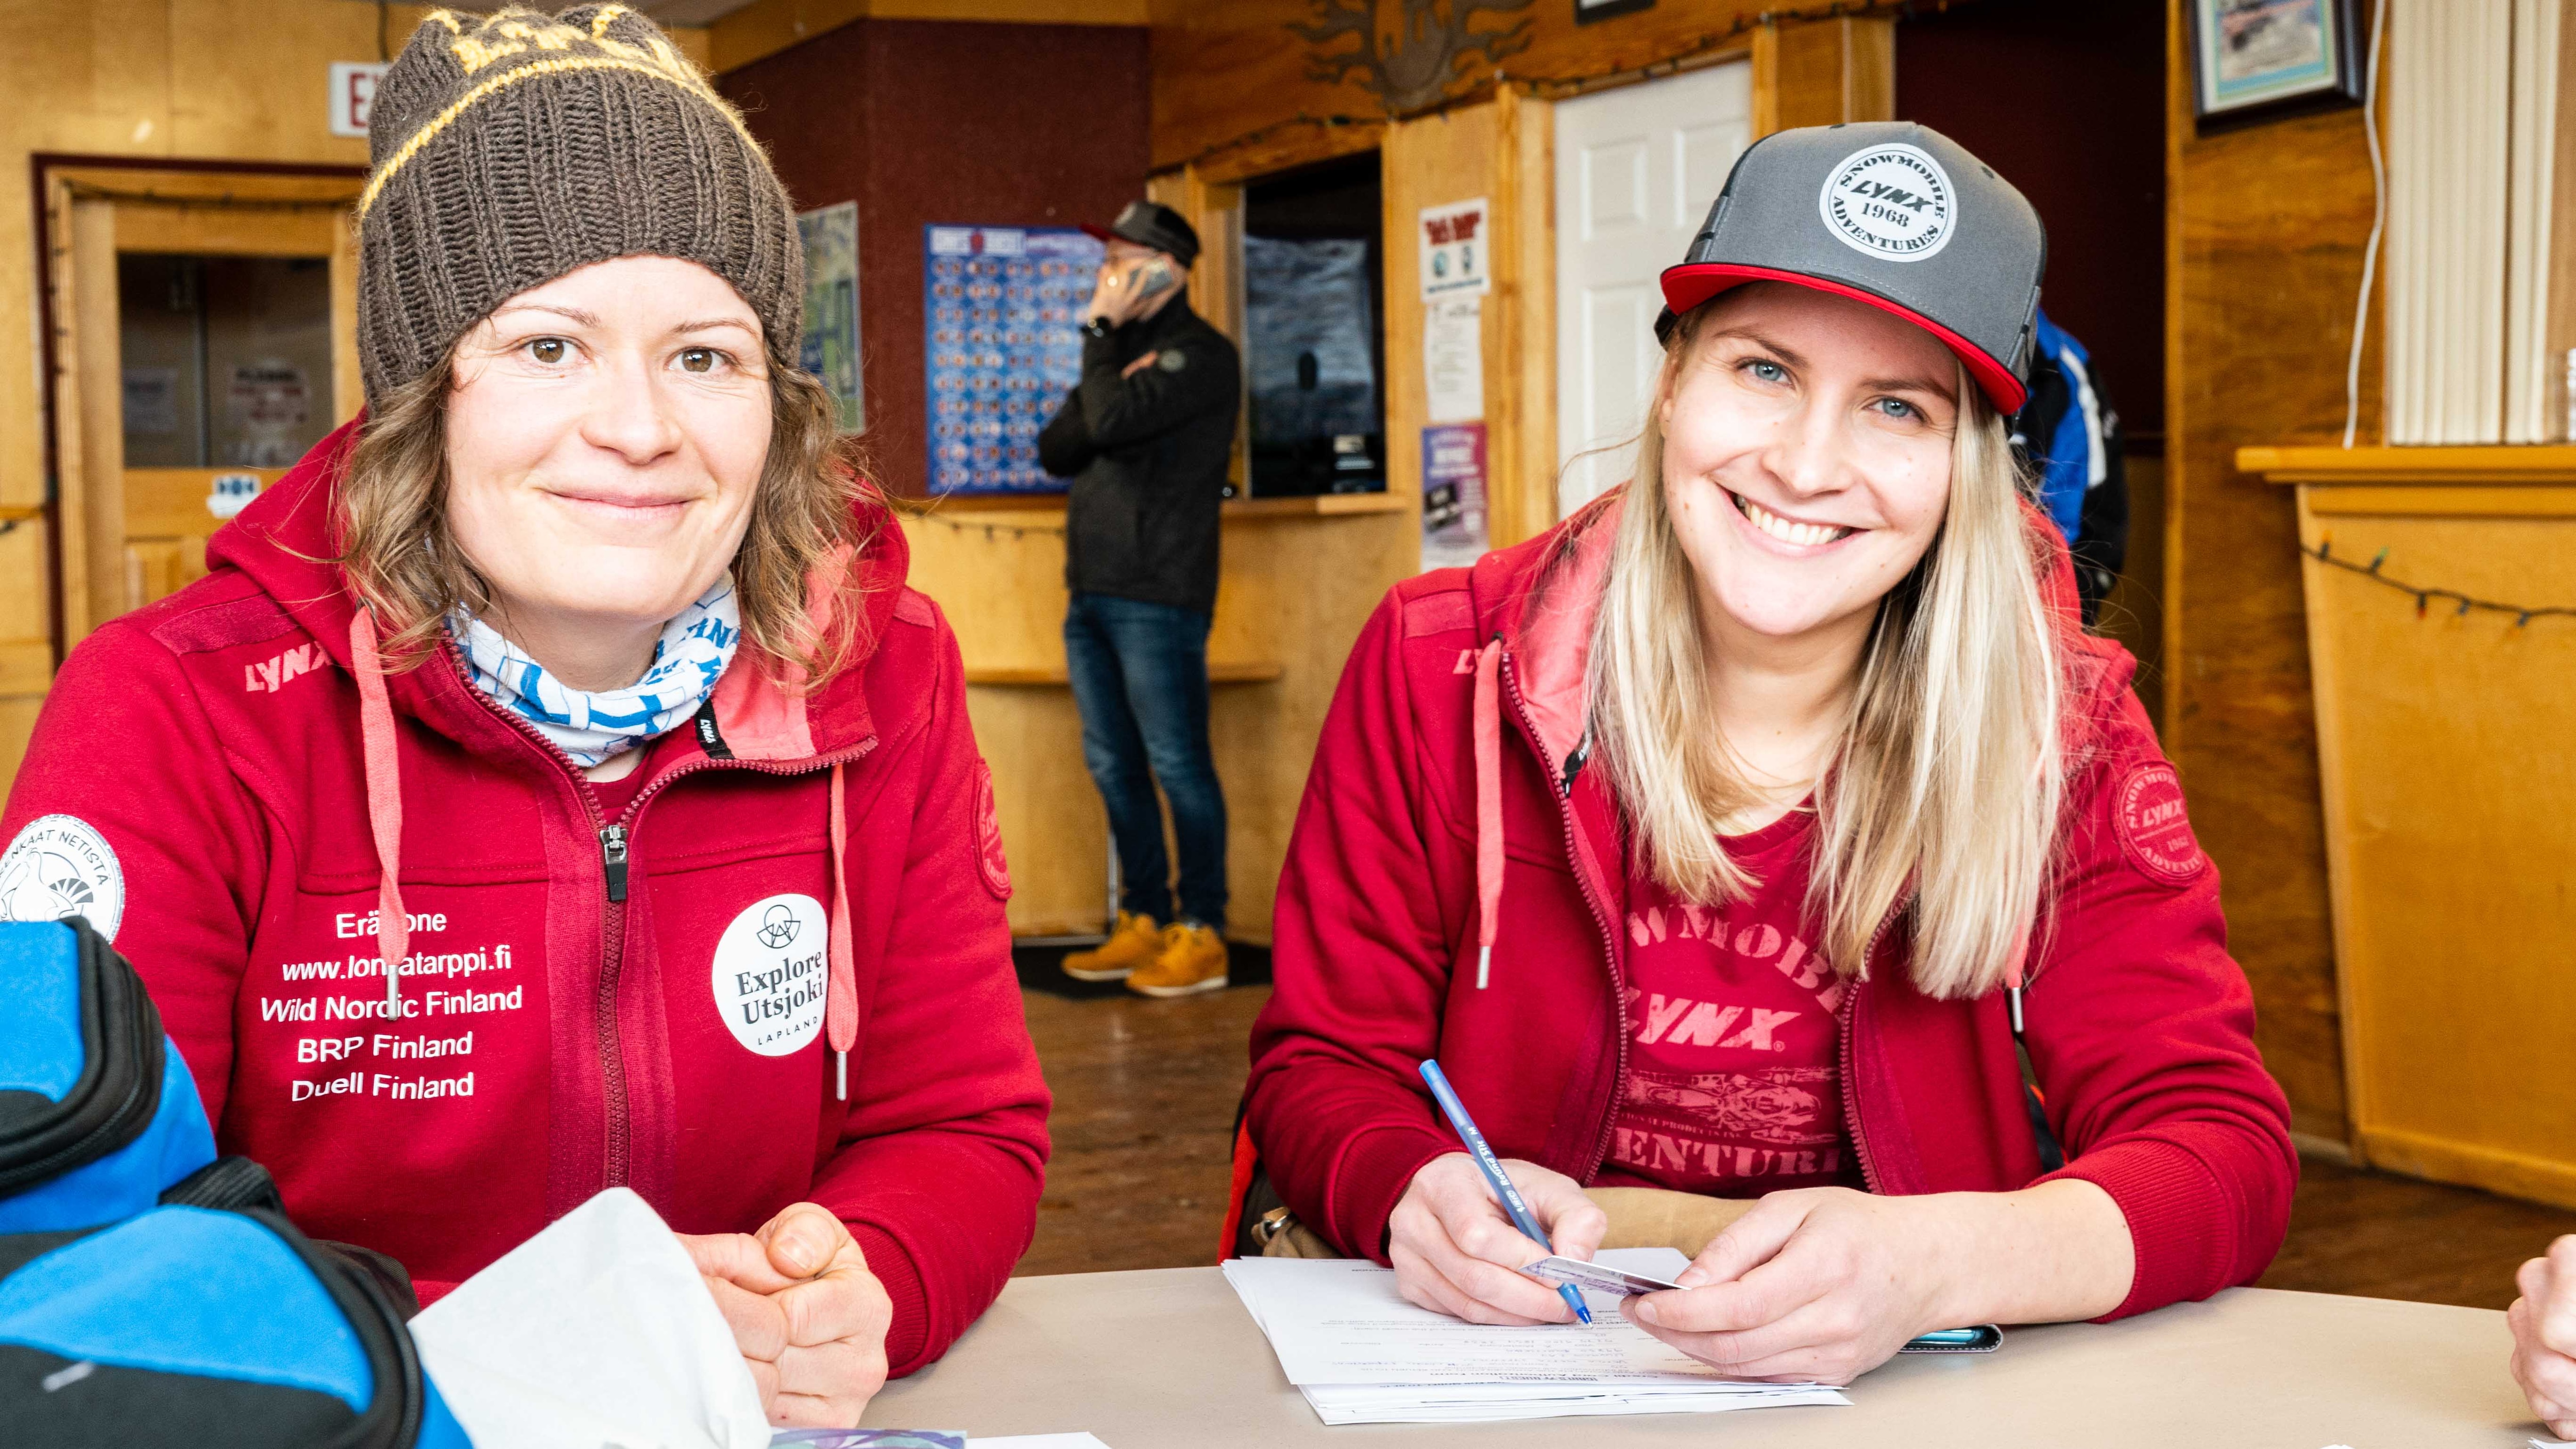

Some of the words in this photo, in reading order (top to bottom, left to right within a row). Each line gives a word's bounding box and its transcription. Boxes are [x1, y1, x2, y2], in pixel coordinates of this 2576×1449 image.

[348, 72, 378, 128] E
[1840, 154, 1945, 219] SNOWMOBILE
[1851, 180, 1935, 213] LYNX
[1834, 196, 1940, 251] ADVENTURES
[1861, 202, 1909, 228] 1968
[245, 640, 333, 693] LYNX
[700, 719, 717, 743] LYNX
[2142, 798, 2184, 828] LYNX
[59, 831, 111, 886] NETISTÄ
[336, 910, 447, 939] Eräone
[735, 951, 822, 996] Explore
[261, 997, 317, 1022] Wild
[426, 984, 523, 1017] Finland
[741, 973, 823, 1025] Utsjoki
[297, 1036, 364, 1063] BRP
[372, 1031, 473, 1059] Finland
[758, 1016, 819, 1046] LAPLAND
[291, 1072, 364, 1102] Duell
[372, 1071, 474, 1100] Finland
[1468, 1127, 1478, 1135] M
[1477, 1140, 1490, 1156] Stic
[1487, 1157, 1510, 1186] Round
